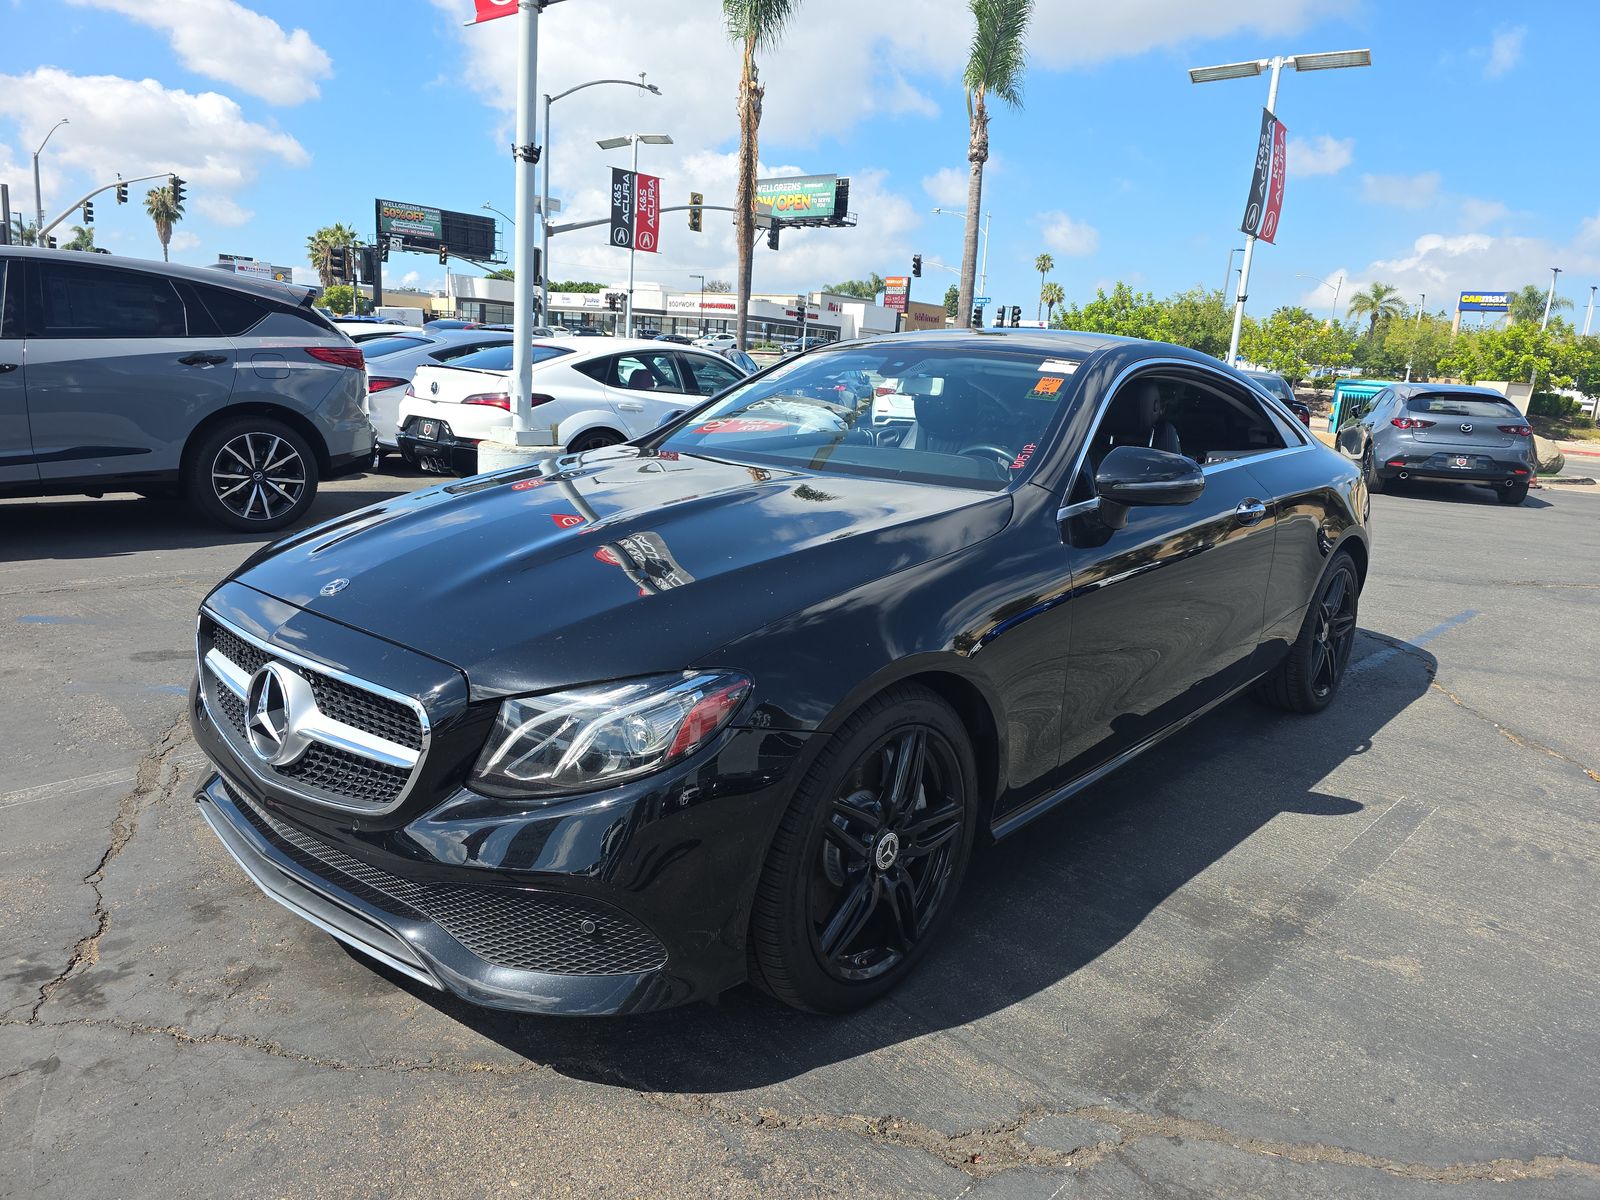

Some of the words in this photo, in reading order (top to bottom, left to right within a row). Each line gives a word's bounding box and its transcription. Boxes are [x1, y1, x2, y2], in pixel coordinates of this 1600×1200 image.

[1257, 134, 1266, 169] K&S
[1259, 120, 1272, 197] ACURA
[1275, 131, 1285, 204] ACURA
[382, 201, 421, 211] WELLGREENS
[614, 183, 622, 206] K&S
[622, 173, 630, 224] ACURA
[639, 188, 647, 212] K&S
[776, 193, 811, 211] OPEN
